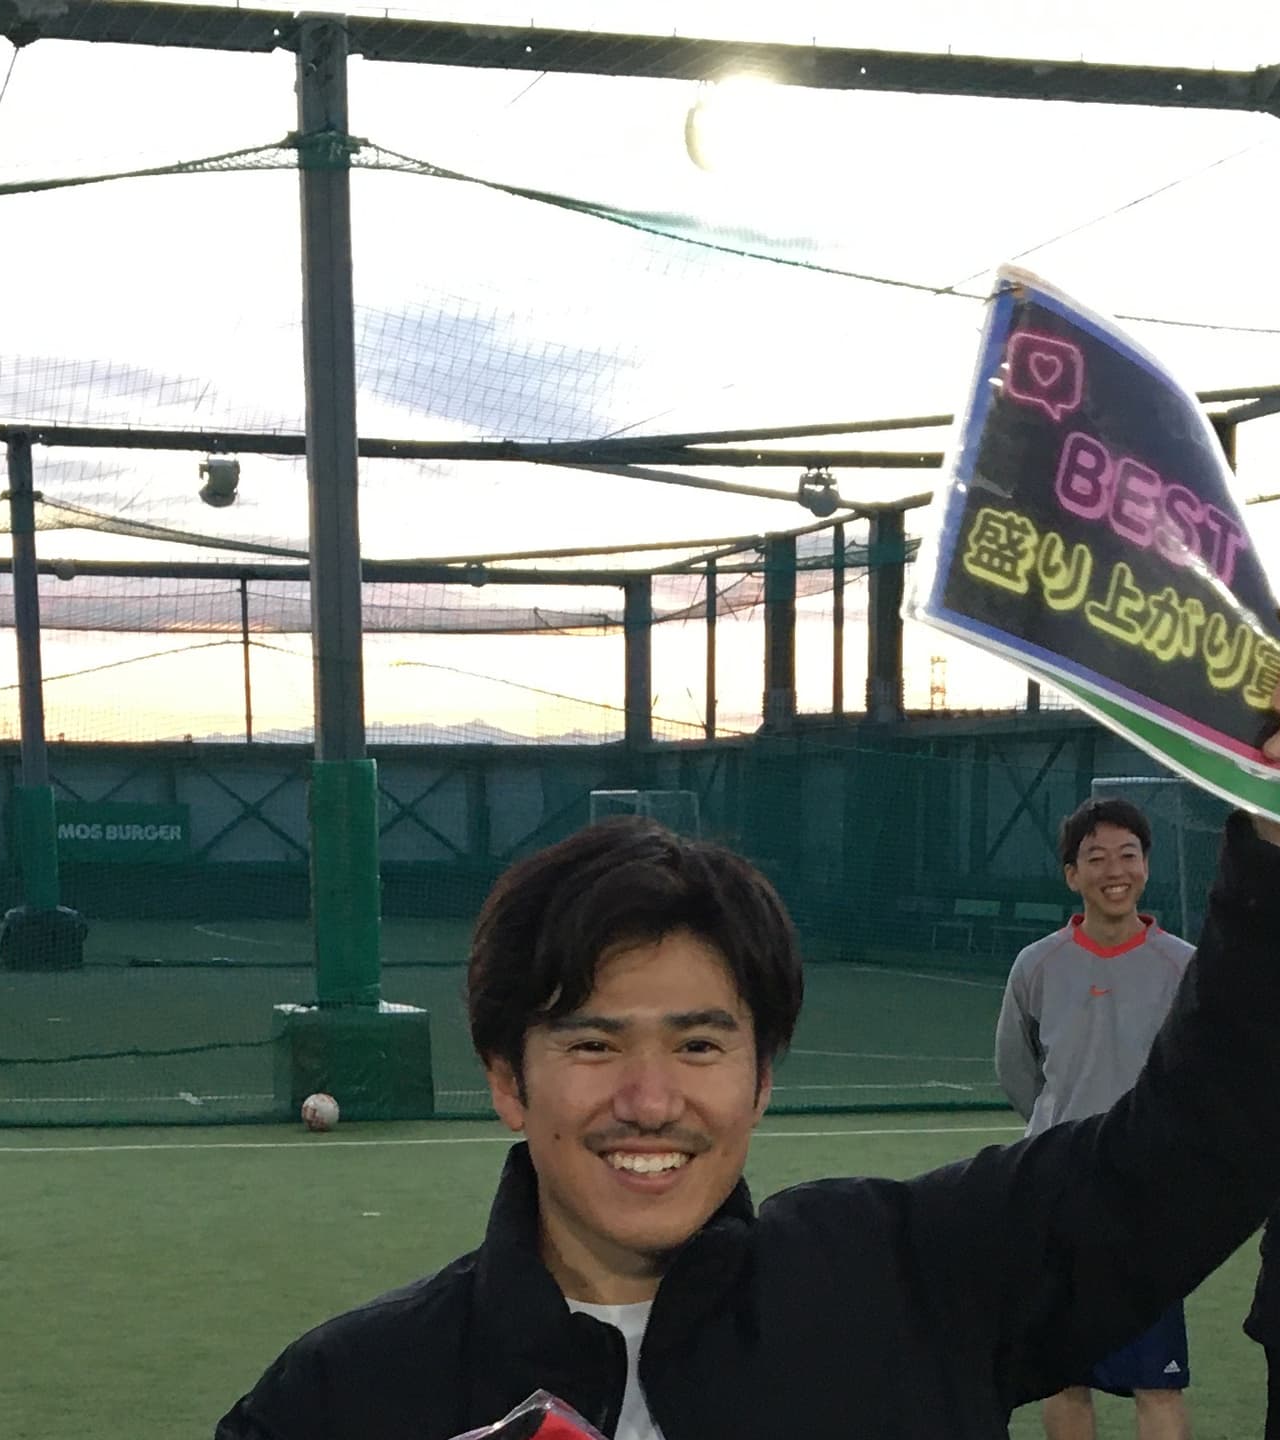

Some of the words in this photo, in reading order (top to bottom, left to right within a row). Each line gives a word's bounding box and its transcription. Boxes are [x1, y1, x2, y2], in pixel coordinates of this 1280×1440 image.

[1056, 432, 1248, 587] BEST
[58, 823, 103, 840] MOS
[106, 824, 181, 841] BURGER
